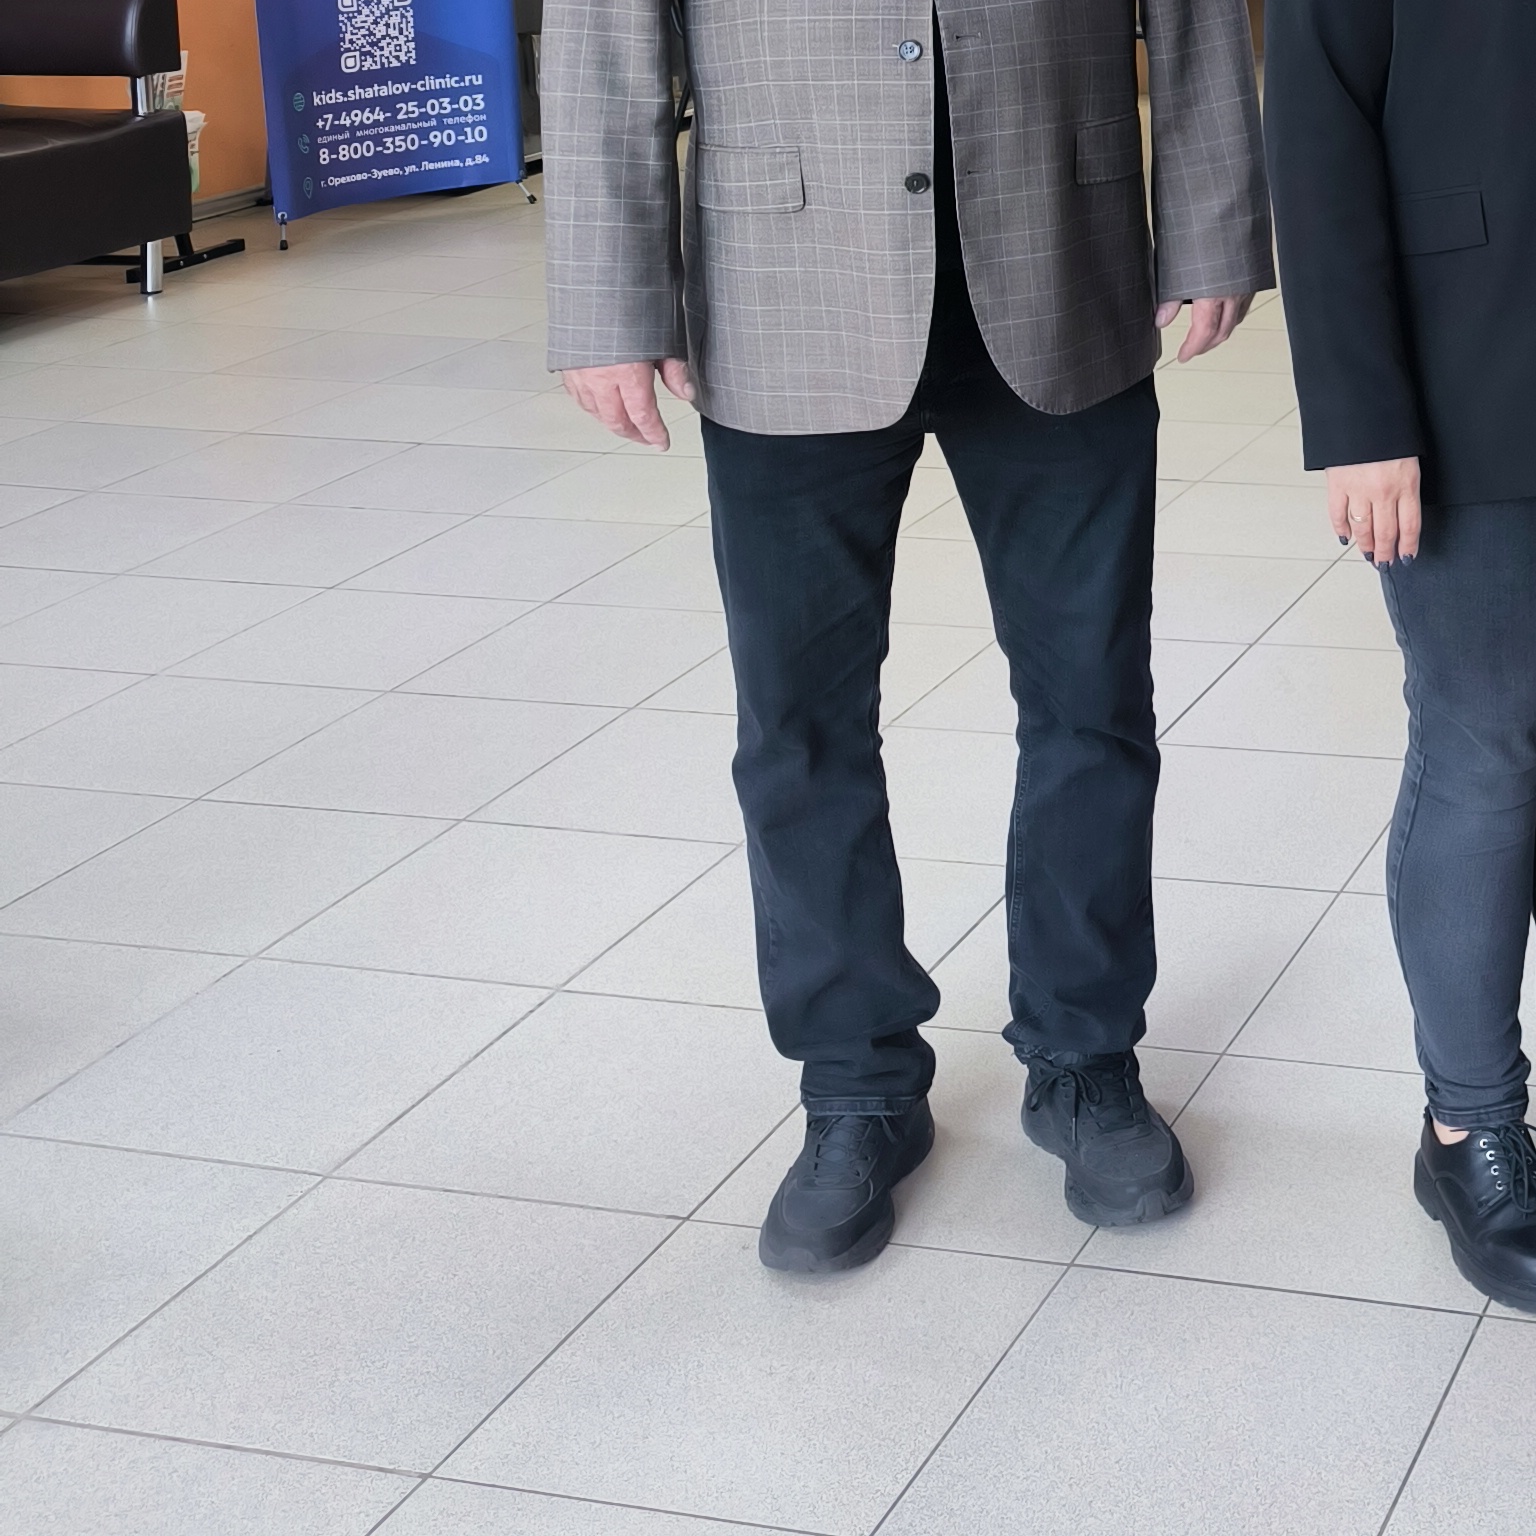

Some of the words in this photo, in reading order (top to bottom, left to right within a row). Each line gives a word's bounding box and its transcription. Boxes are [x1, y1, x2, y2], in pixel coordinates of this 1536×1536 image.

[312, 73, 483, 107] kids.shatalov-clinic.ru
[316, 104, 392, 132] +7-4964-
[396, 93, 485, 120] 25-03-03
[317, 129, 350, 145] единый
[355, 118, 437, 138] многоканальный
[442, 113, 487, 127] телефон
[319, 125, 488, 165] 8-800-350-90-10
[320, 179, 327, 188] г.
[328, 165, 402, 187] Орехово-Зуево,
[404, 162, 419, 175] ул.
[421, 157, 463, 172] Ленина,
[465, 153, 489, 167] д.84
